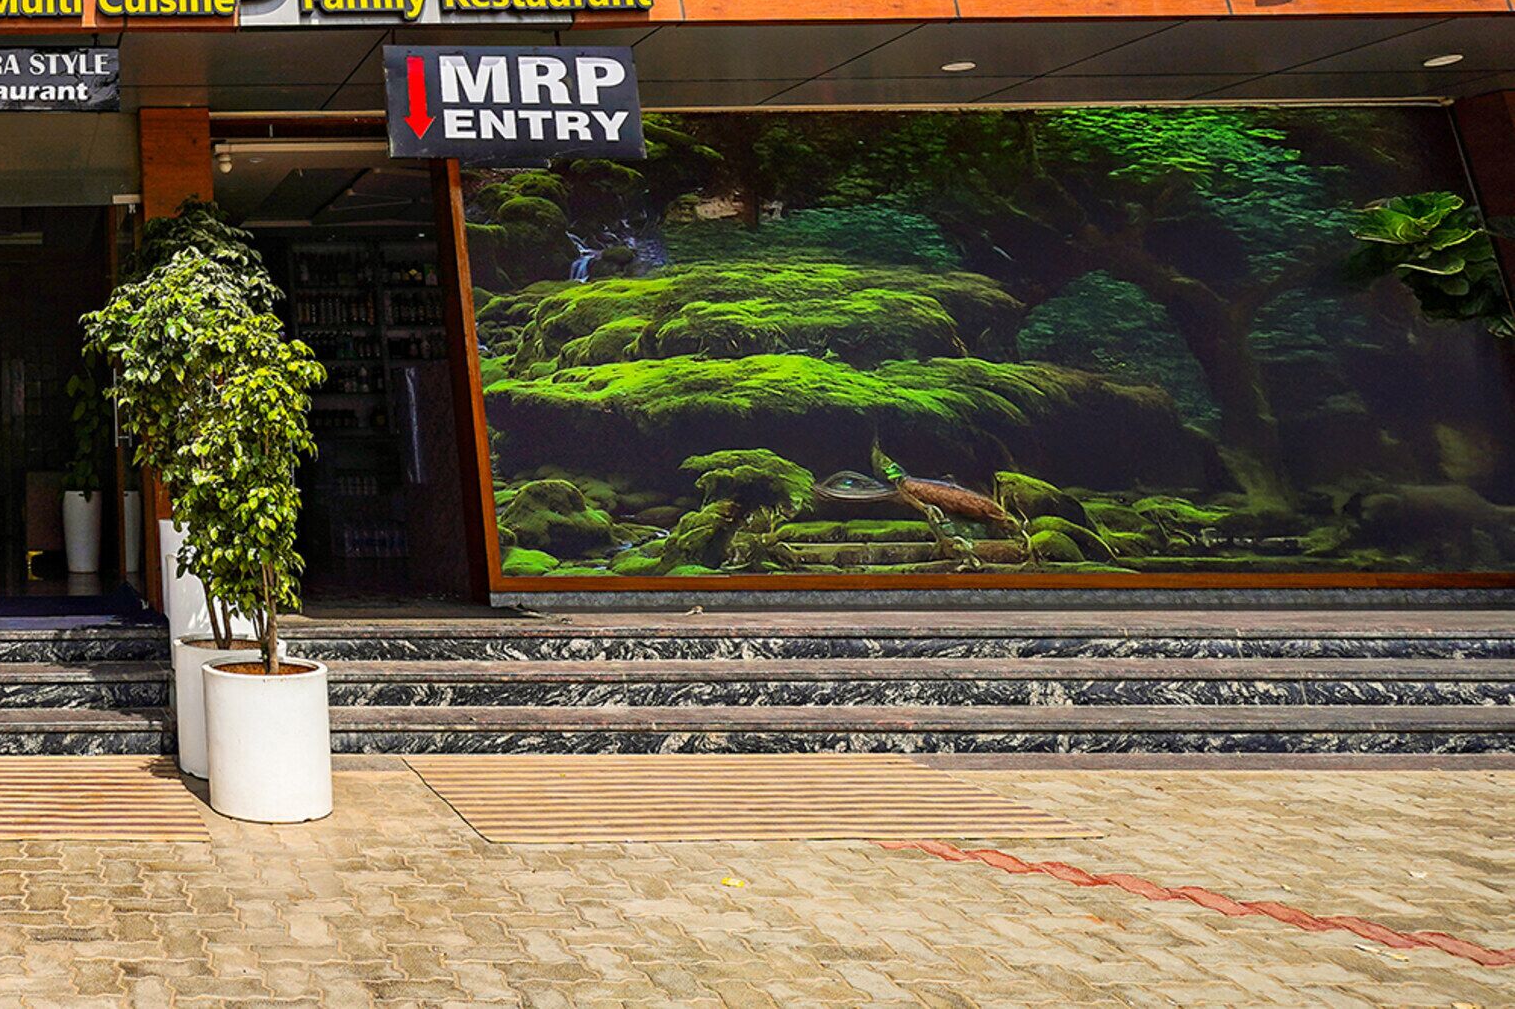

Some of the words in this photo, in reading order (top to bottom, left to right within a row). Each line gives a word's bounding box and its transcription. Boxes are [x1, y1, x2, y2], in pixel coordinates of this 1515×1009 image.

[28, 53, 111, 76] STYLE
[439, 54, 627, 106] MRP
[442, 109, 630, 141] ENTRY
